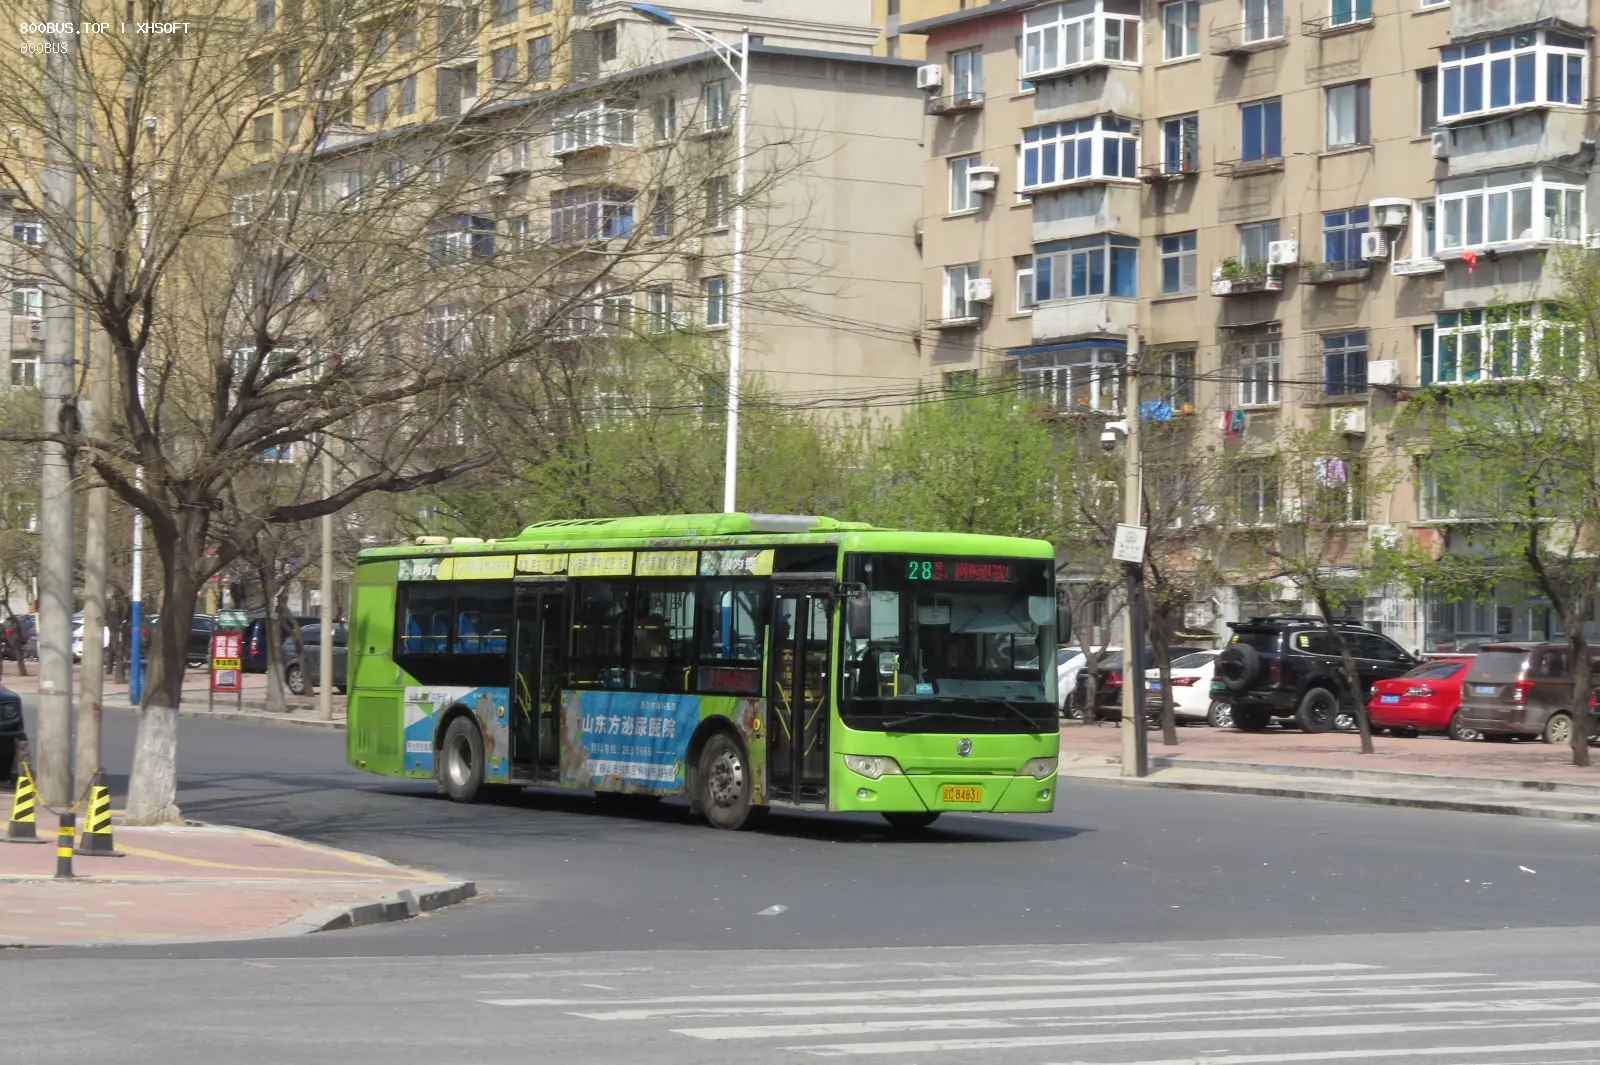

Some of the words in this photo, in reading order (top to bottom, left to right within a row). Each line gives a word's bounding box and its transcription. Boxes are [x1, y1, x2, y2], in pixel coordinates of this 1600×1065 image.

[909, 560, 932, 580] 28
[582, 713, 676, 739] 山东方泌尿医院
